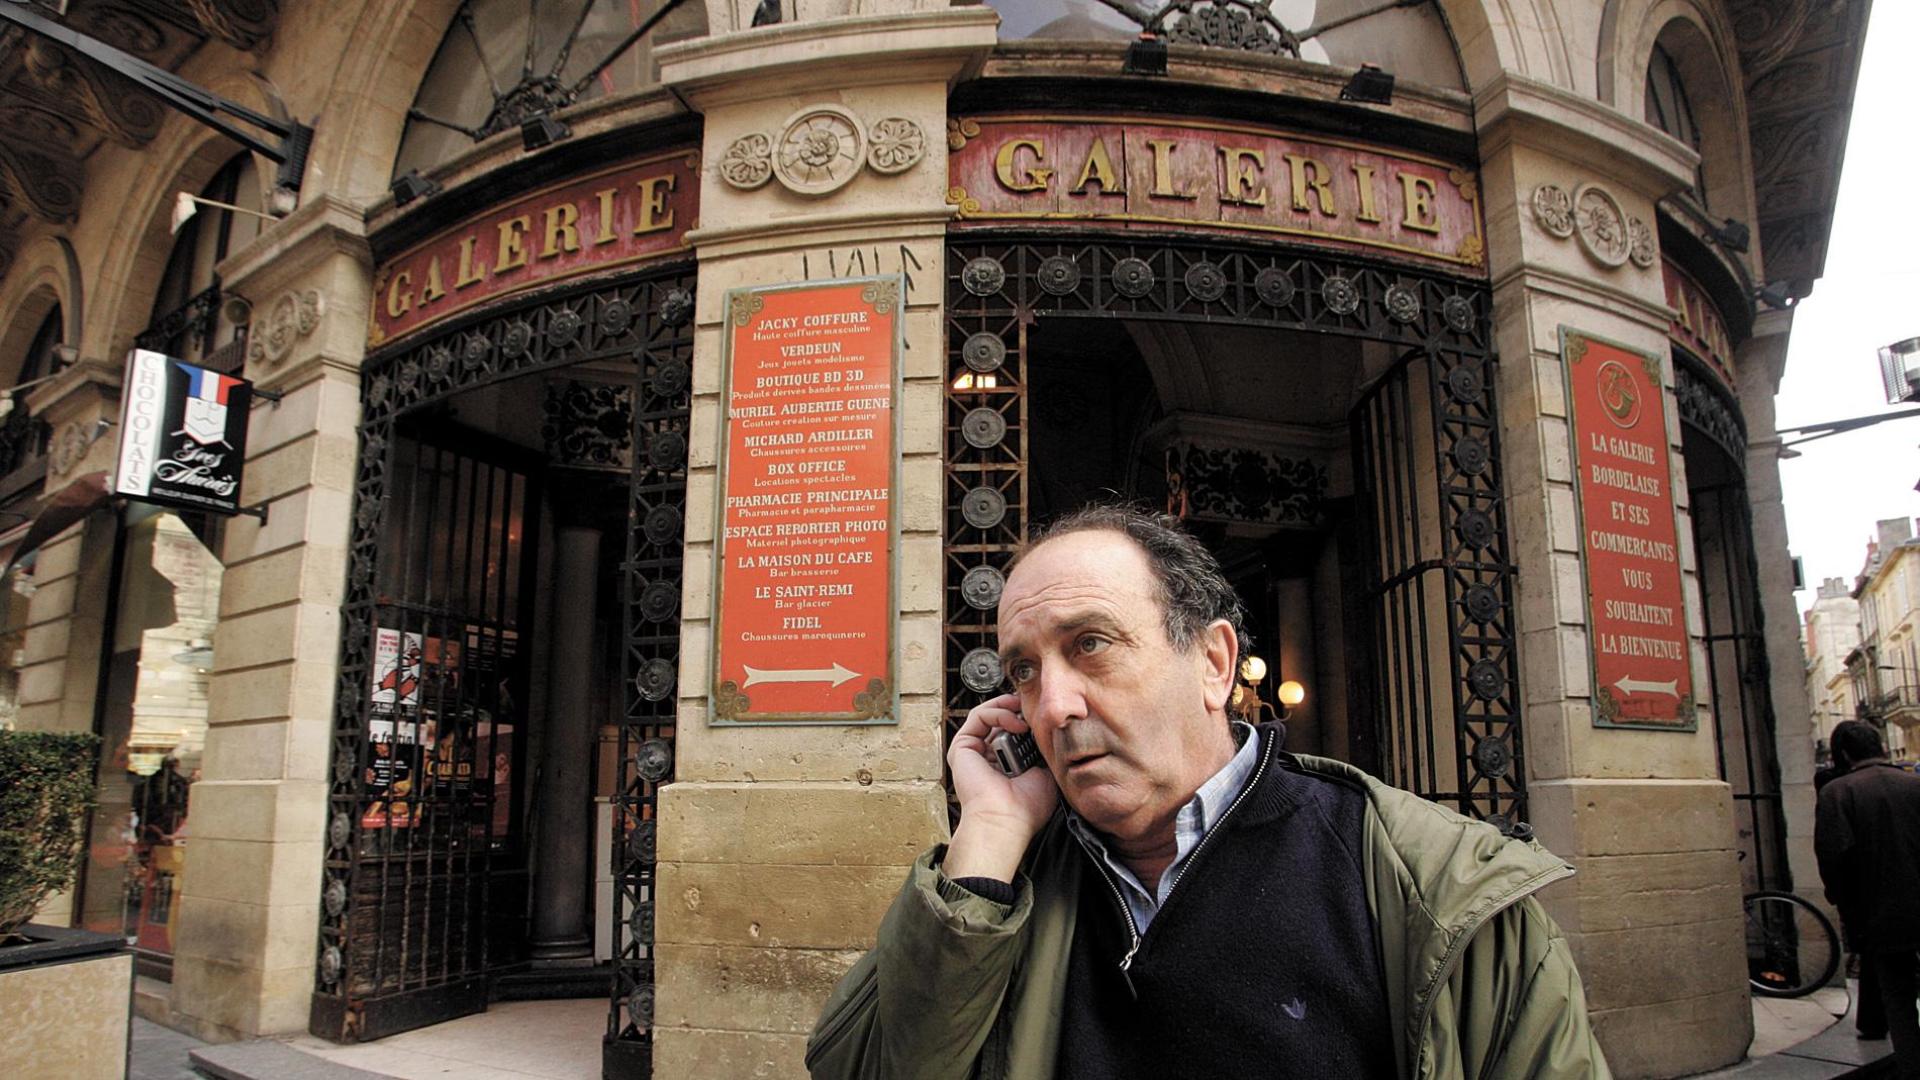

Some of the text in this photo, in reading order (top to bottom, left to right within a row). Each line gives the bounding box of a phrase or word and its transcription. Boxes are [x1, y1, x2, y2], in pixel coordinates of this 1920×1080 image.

[994, 138, 1441, 235] GALERIE
[387, 174, 675, 318] GALERIE
[758, 312, 867, 331] JACKY COIFFURE
[753, 325, 870, 341] Haute coiffure masculine
[781, 342, 841, 357] VERDEUN
[757, 360, 779, 369] Jeux
[782, 358, 811, 369] jouets
[756, 370, 864, 388] BOUTIQUE BD 3D
[733, 389, 770, 400] Produits
[809, 384, 840, 393] bandes
[730, 398, 890, 419] MURIEL AUBERTIE GUENE
[126, 355, 160, 490] CHOCOLATS
[742, 418, 779, 428] Couture
[842, 413, 877, 423] mesure
[745, 429, 873, 447] MICHARD ARDILLER
[173, 440, 226, 467] Yves
[750, 444, 866, 457] Chaussures accessoires
[1591, 433, 1656, 465] LA GALERIE
[768, 460, 845, 475] BOX OFFICE
[755, 474, 856, 486] Locations spectacles
[1593, 465, 1660, 496] BORDELAISE
[728, 489, 888, 507] PHARMACIE PRINCIPALE
[739, 503, 876, 518] Pharmacie et parapharmacie
[1611, 501, 1649, 526] ET SES
[725, 525, 773, 538] ESPACE
[845, 520, 886, 532] PHOTO
[791, 534, 866, 547] photographique
[738, 551, 872, 568] LA MAISON DU CAFE
[770, 567, 839, 577] Bar brasserie
[1622, 568, 1653, 591] VOUS
[755, 583, 853, 598] LE SAINT-REMI
[775, 599, 832, 609] Bar glacier
[1606, 600, 1673, 626] SOUHAITENT
[783, 617, 821, 629] FIDEL
[742, 631, 866, 642] Chaussures maroquinerie
[1602, 633, 1682, 660] LA BIENVENUE
